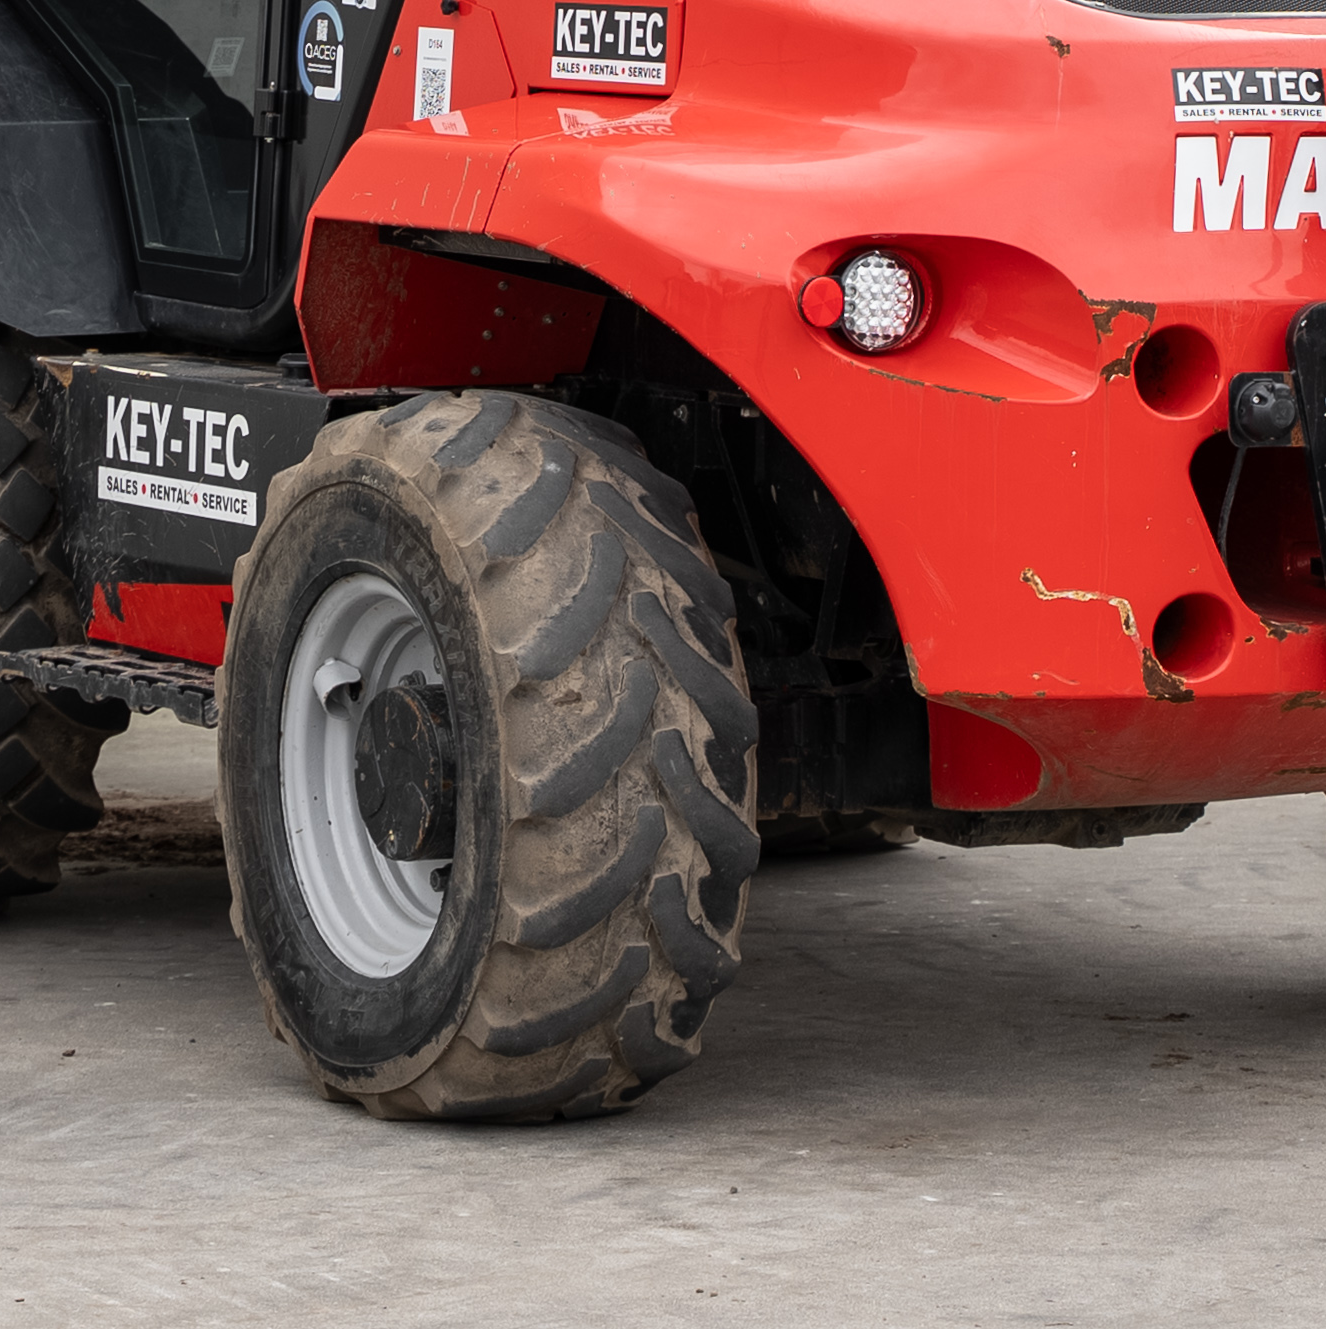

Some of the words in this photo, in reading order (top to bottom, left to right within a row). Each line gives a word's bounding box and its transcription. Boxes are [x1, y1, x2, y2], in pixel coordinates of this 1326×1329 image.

[556, 8, 664, 57] KEY-TEC
[556, 62, 580, 74] SALES
[588, 63, 619, 76] RENTAL
[628, 66, 662, 79] SERVICE
[1176, 71, 1322, 103] KEY-TEC
[1182, 109, 1216, 117] SALES
[1228, 108, 1268, 116] RENTAL
[1280, 108, 1322, 117] SERVICE
[106, 395, 250, 481] KEY-TEC
[106, 475, 138, 496] SALES
[149, 483, 190, 505] RENTAL
[202, 492, 248, 515] SERVICE
